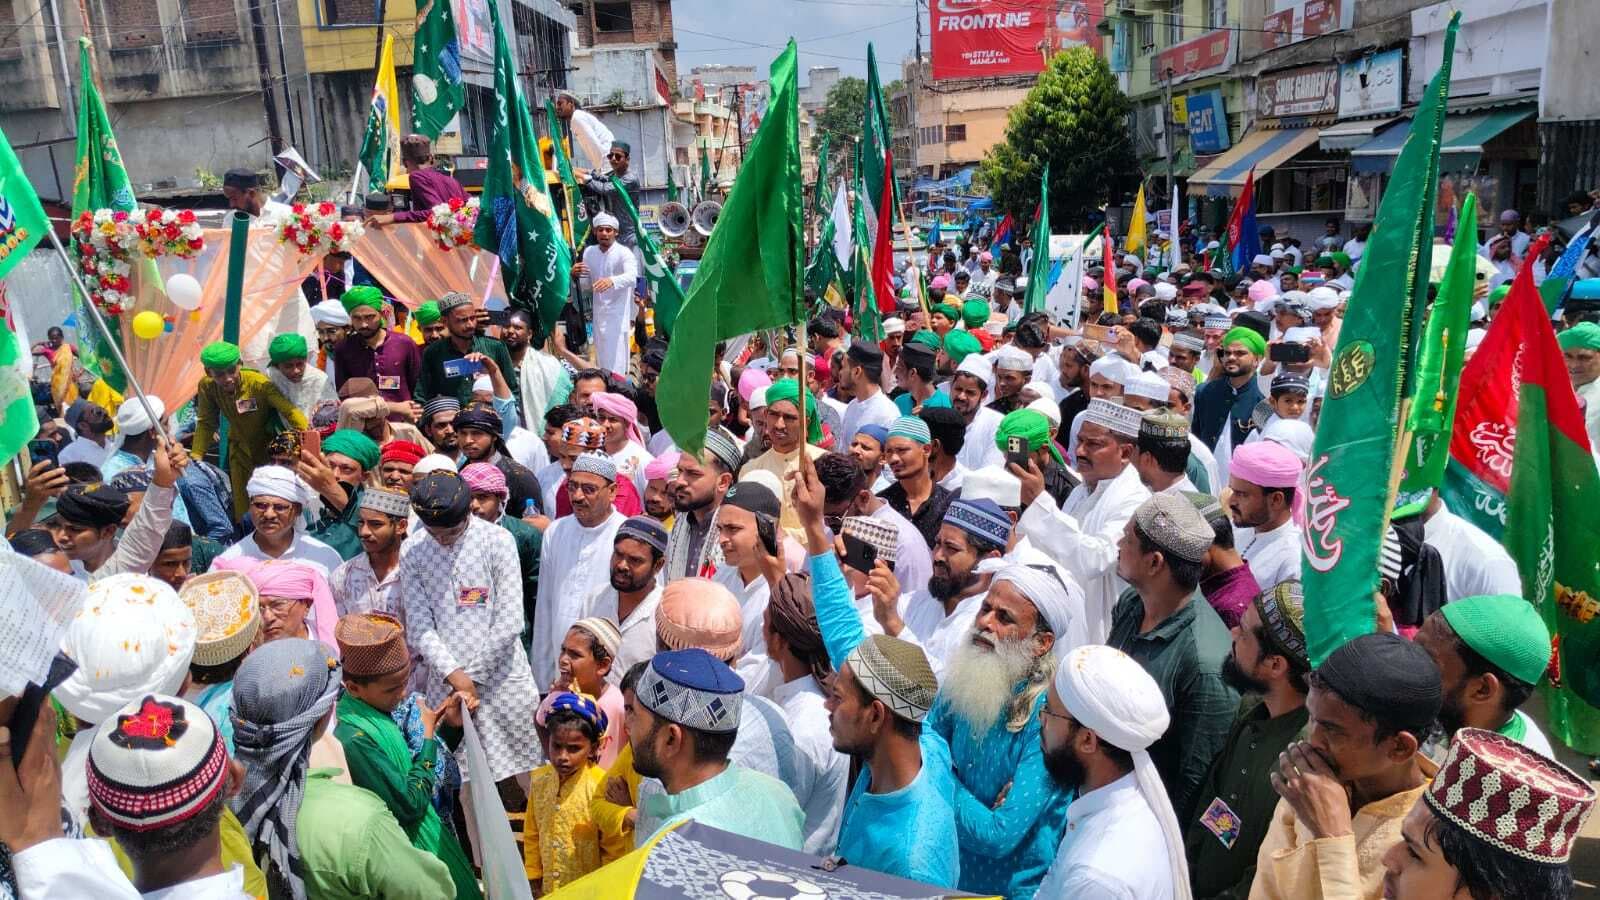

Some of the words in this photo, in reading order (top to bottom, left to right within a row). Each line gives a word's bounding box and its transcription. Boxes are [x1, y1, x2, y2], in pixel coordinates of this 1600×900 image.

[938, 12, 1031, 31] FRONTLINE
[970, 57, 996, 65] MAMLA
[973, 50, 995, 58] STYLE
[1276, 78, 1295, 103] SHOE
[1296, 71, 1326, 99] GARDEN
[1189, 108, 1212, 134] CEAT
